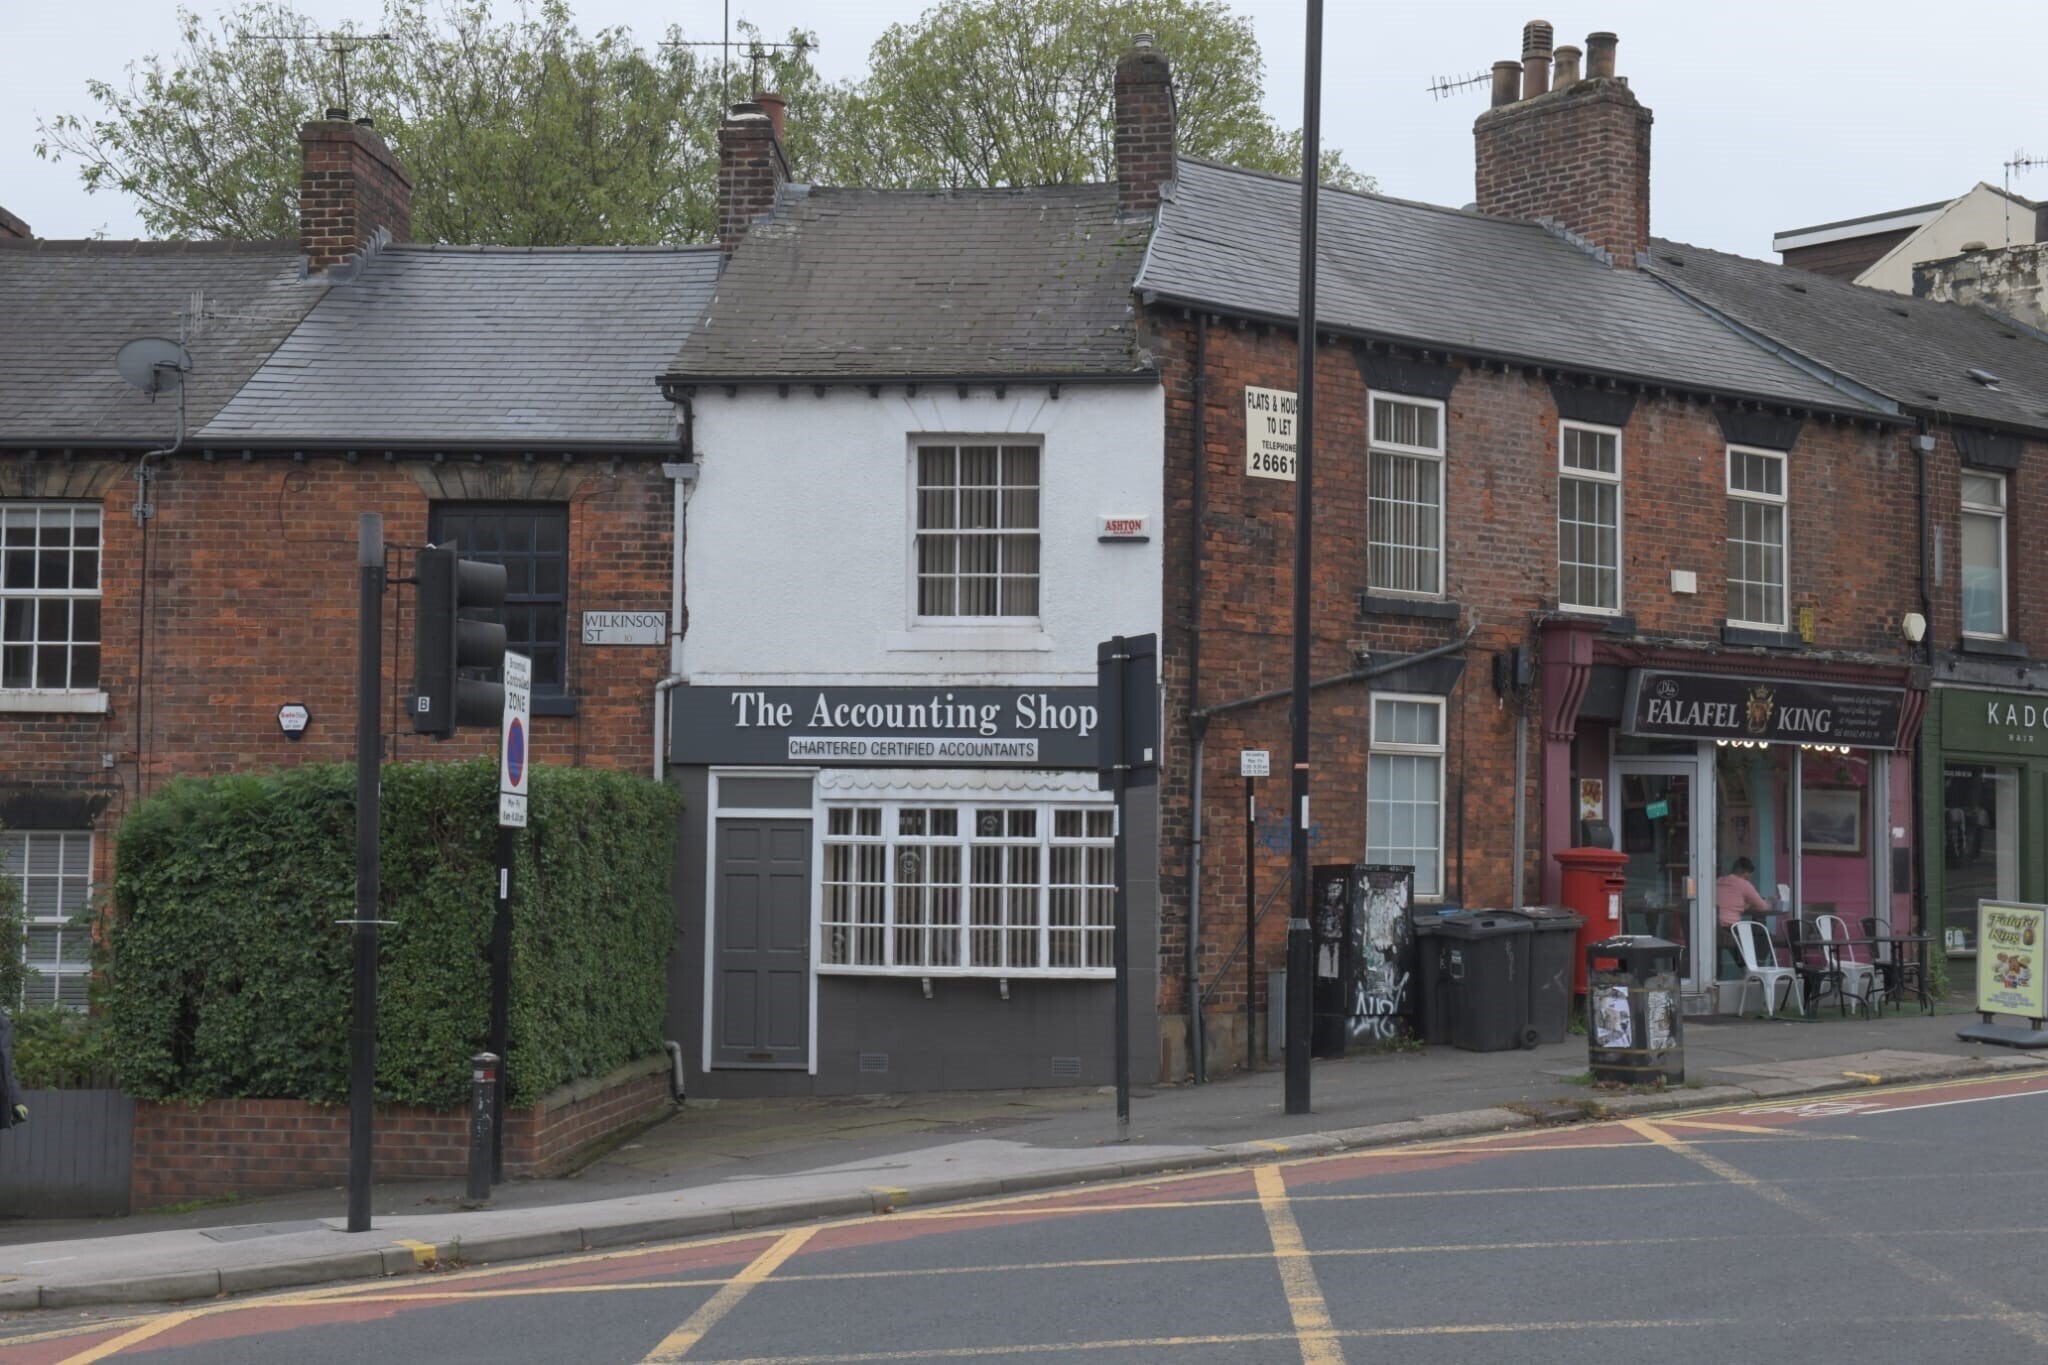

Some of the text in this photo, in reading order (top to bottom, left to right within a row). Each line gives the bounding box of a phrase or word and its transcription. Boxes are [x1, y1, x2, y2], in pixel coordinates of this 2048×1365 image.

[1247, 392, 1270, 411] FLATS
[1272, 394, 1278, 413] &
[1267, 416, 1292, 436] TO LET
[1262, 440, 1297, 453] TELEPHONE
[1252, 452, 1297, 475] 26661
[1104, 519, 1142, 531] ASHTON
[585, 614, 664, 628] WILKINSON
[420, 698, 428, 710] B
[509, 691, 525, 713] ZONE
[731, 692, 1099, 737] The Accounting Shop
[1647, 698, 1832, 733] FALAFEL KING
[790, 741, 1035, 757] CHARTERED CERTIFIED ACCOUNTANTS
[1988, 912, 2039, 929] Falafel
[1988, 928, 2020, 945] King
